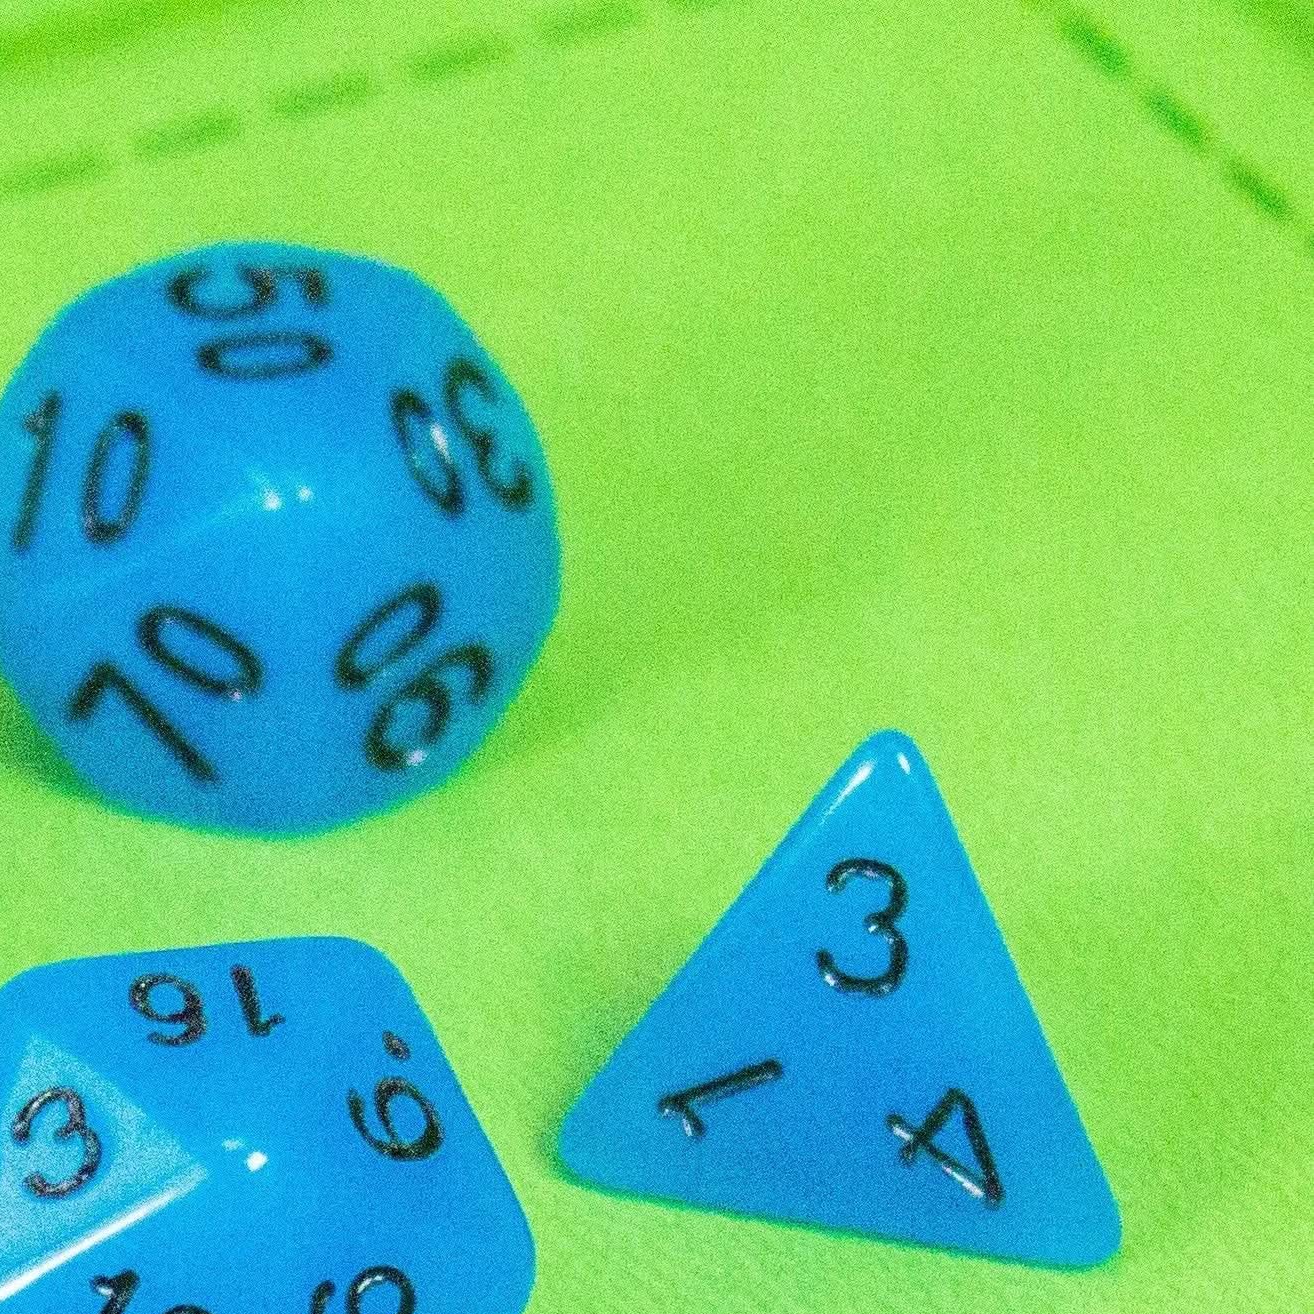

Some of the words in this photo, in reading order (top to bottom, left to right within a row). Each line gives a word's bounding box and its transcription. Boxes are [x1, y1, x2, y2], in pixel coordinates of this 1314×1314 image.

[169, 265, 332, 378] 50
[11, 392, 148, 555] 10
[391, 358, 532, 518] 30
[66, 606, 263, 784] 70
[817, 858, 908, 997] 3
[129, 964, 284, 1046] 16
[11, 1086, 101, 1200] 3
[658, 1059, 781, 1140] 1
[887, 1087, 1004, 1208] 4
